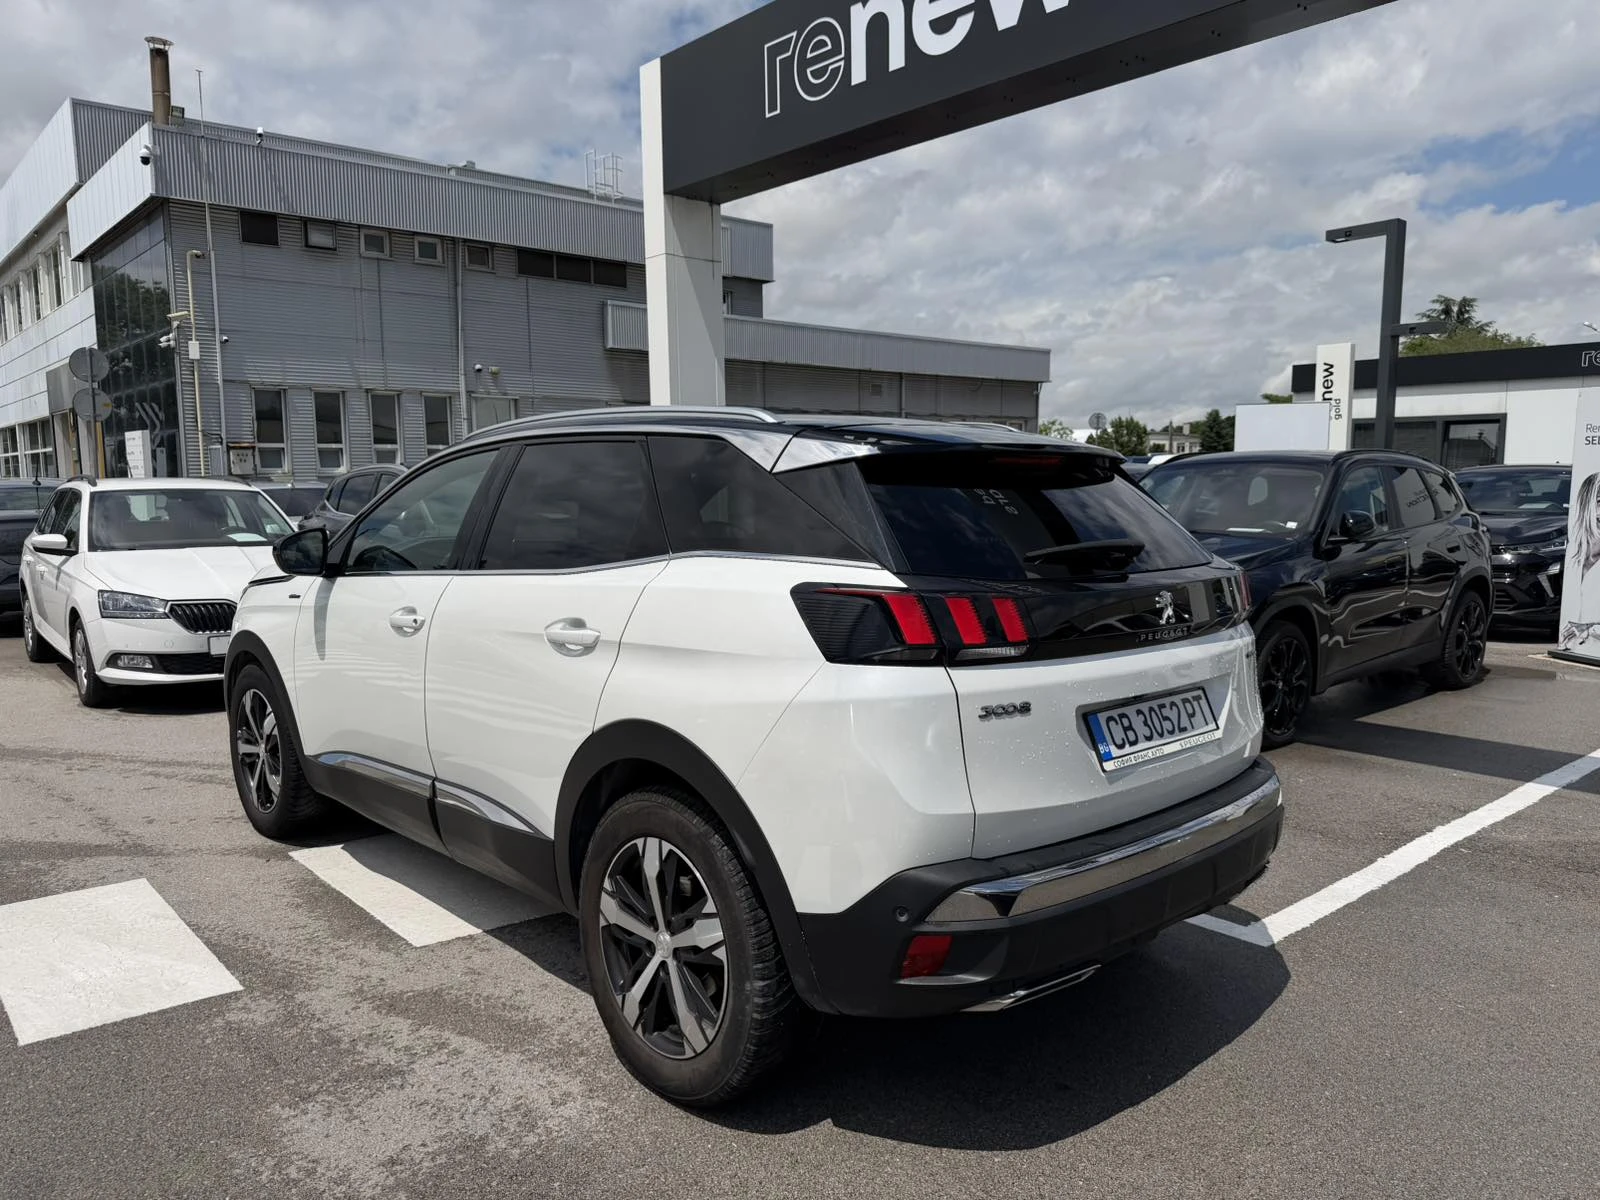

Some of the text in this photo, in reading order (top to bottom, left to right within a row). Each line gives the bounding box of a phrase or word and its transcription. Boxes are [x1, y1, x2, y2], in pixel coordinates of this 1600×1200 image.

[764, 0, 1070, 118] rene
[1322, 362, 1334, 402] new
[1333, 398, 1342, 421] gold
[1140, 627, 1188, 641] PEUGEOT
[978, 701, 1031, 720] 3008
[1099, 743, 1110, 754] BG
[1183, 732, 1217, 748] PEUGEOT
